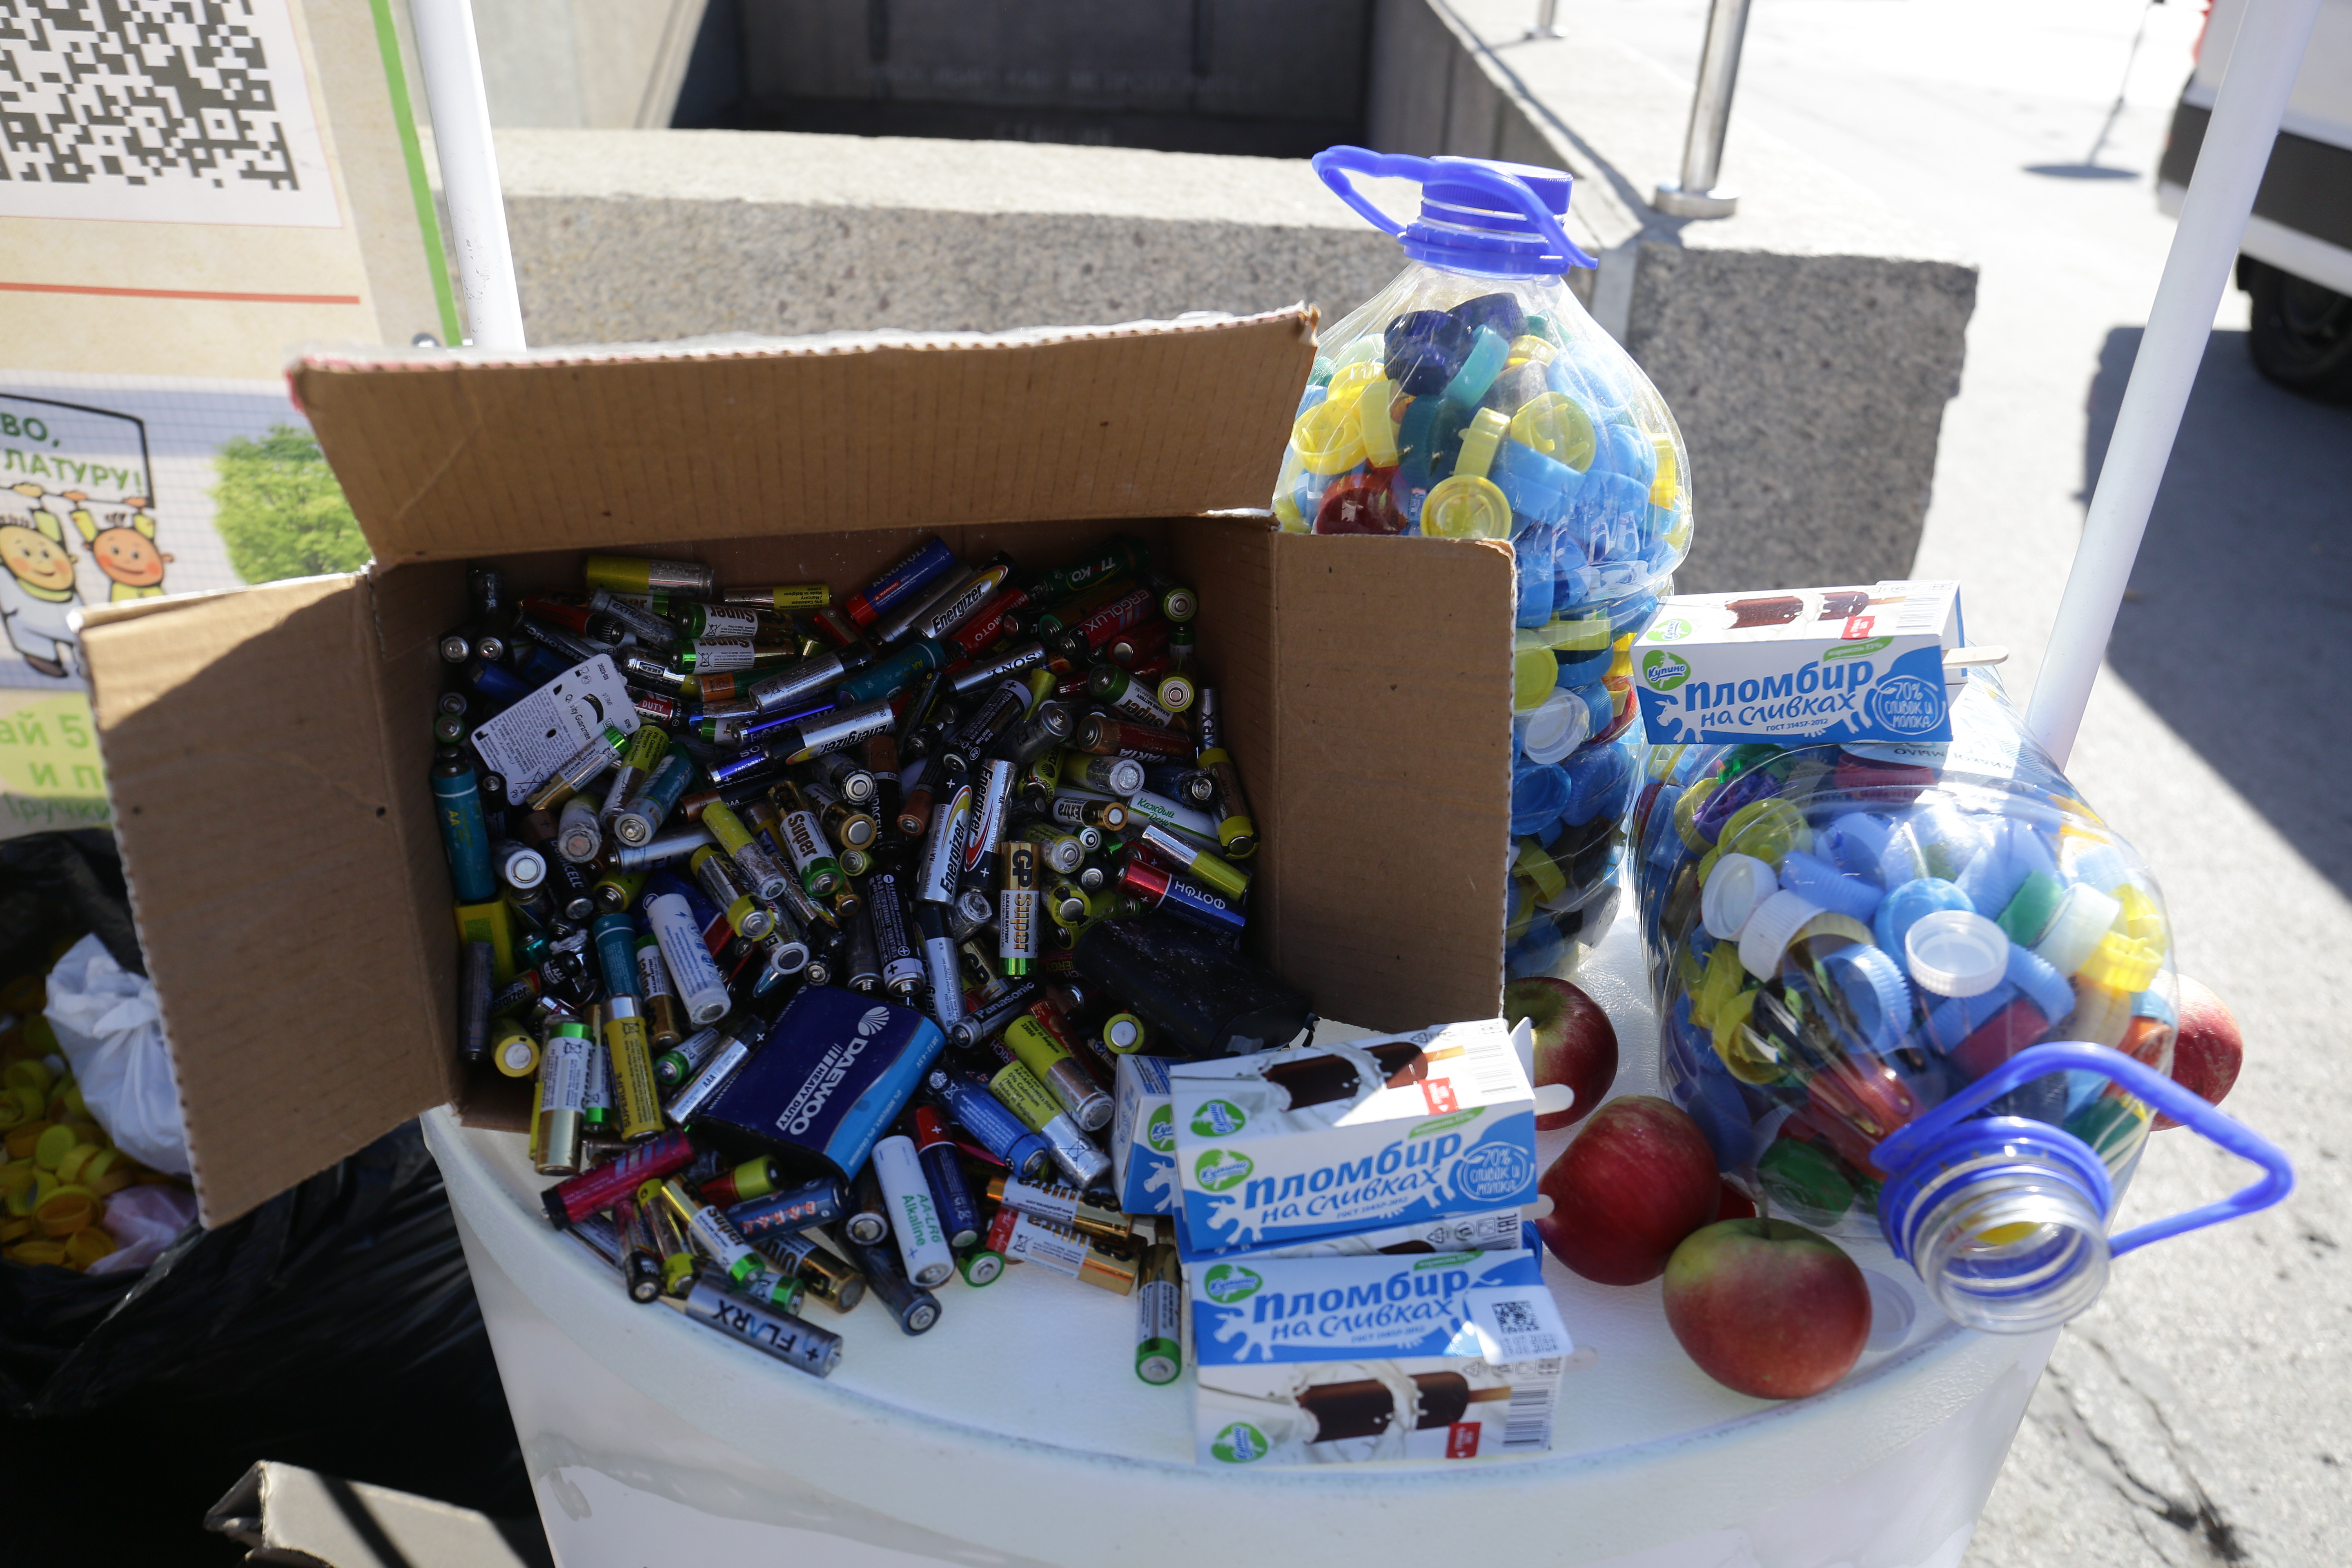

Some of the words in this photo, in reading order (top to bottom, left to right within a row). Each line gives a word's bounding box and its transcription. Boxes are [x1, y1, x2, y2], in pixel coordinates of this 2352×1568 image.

[710, 605, 755, 624] Super
[931, 584, 982, 634] Energizer
[1085, 589, 1149, 632] ERGOLUX
[640, 664, 662, 674] IKEA
[990, 653, 1037, 679] SONY
[1648, 663, 1686, 681] Купино
[1203, 710, 1215, 748] ARX
[1701, 711, 1733, 728] на
[1766, 723, 1785, 732] ГОСТ
[819, 724, 889, 754] Energizer
[970, 765, 993, 837] Energizer
[1137, 797, 1175, 819] Каждый
[788, 814, 818, 858] Super
[940, 819, 966, 897] Energizer
[1011, 849, 1033, 887] GP
[1174, 880, 1226, 910] ФОТОН
[1010, 893, 1032, 953] Super
[492, 989, 528, 1012] ergizer
[977, 982, 1035, 1018] Panasonic
[789, 1037, 868, 1136] DAEWOO
[797, 1066, 824, 1105] HEAVY
[1015, 1080, 1040, 1107] Cadmium
[778, 1104, 798, 1129] DUTY
[901, 1195, 926, 1247] Alkaline
[1262, 1203, 1300, 1224] на
[1270, 1321, 1312, 1341] на
